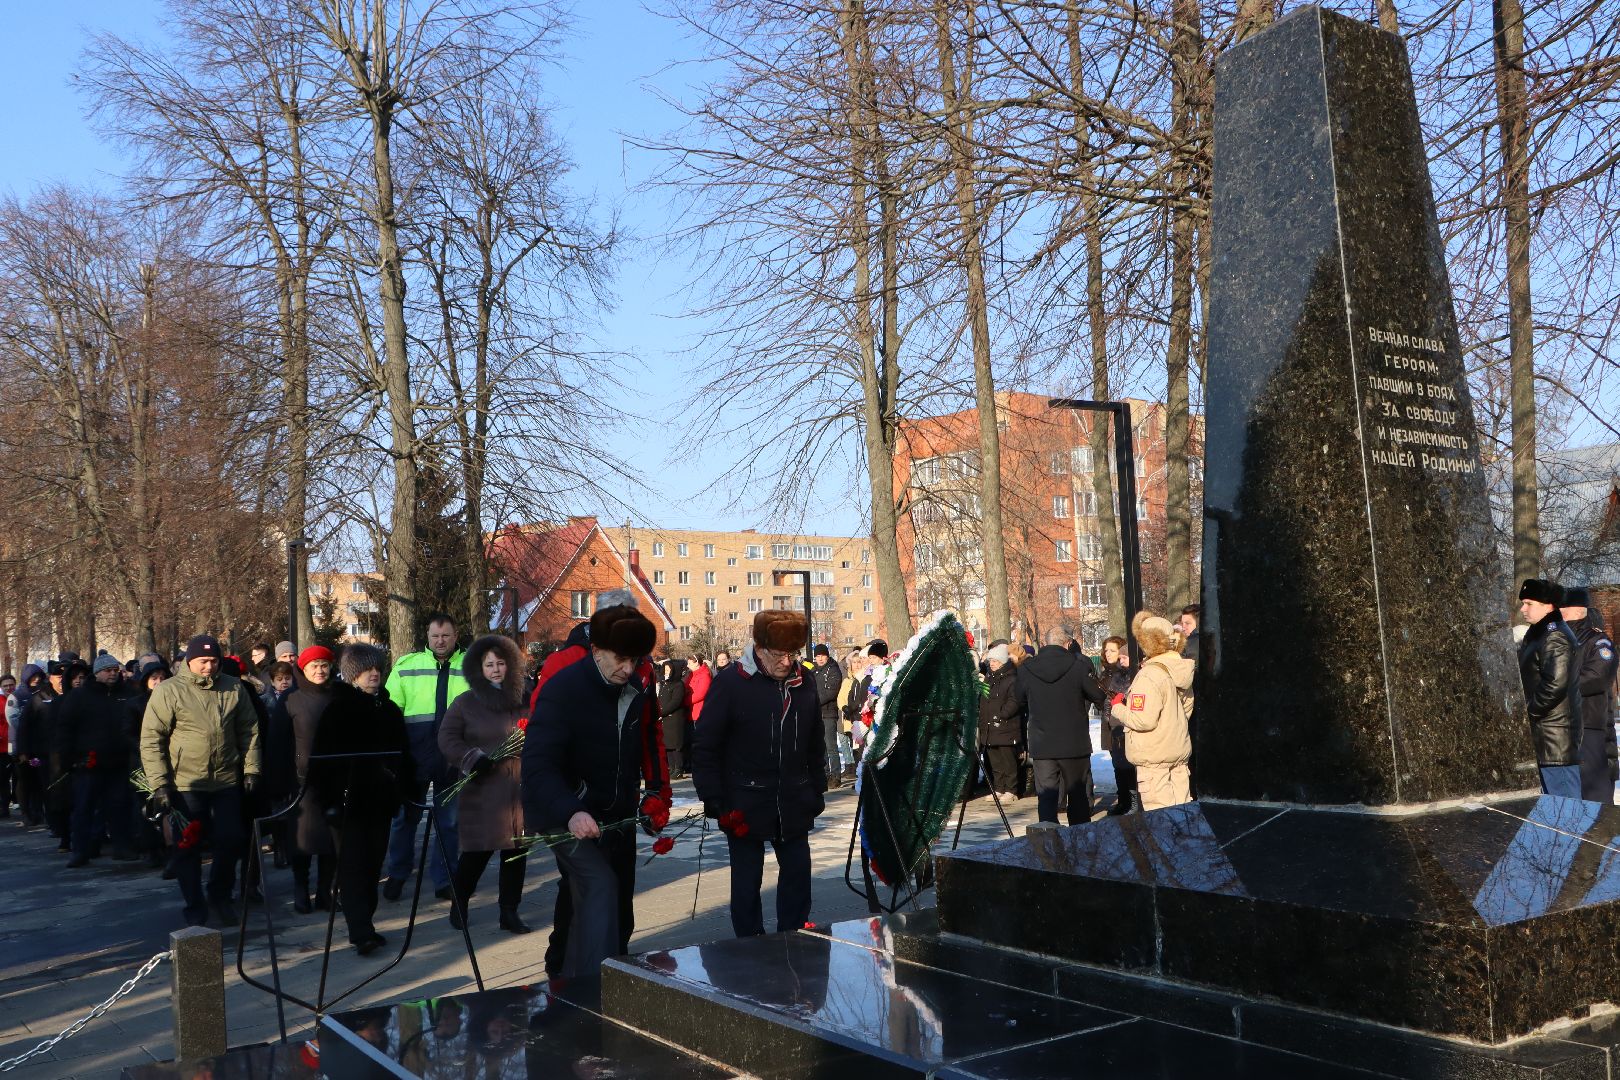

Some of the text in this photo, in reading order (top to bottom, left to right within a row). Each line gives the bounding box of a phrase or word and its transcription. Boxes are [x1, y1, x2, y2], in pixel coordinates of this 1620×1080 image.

[1369, 327, 1445, 353] ВЕЧНАЯ СЛАВА
[1369, 377, 1455, 400] ПАВШИМ В БОЯХ
[1382, 403, 1455, 427] ЗА СВОБОДУ
[1378, 426, 1467, 449] И НЕЗАВИСИМОСТЬ
[1372, 450, 1415, 467] НАШЕЙ
